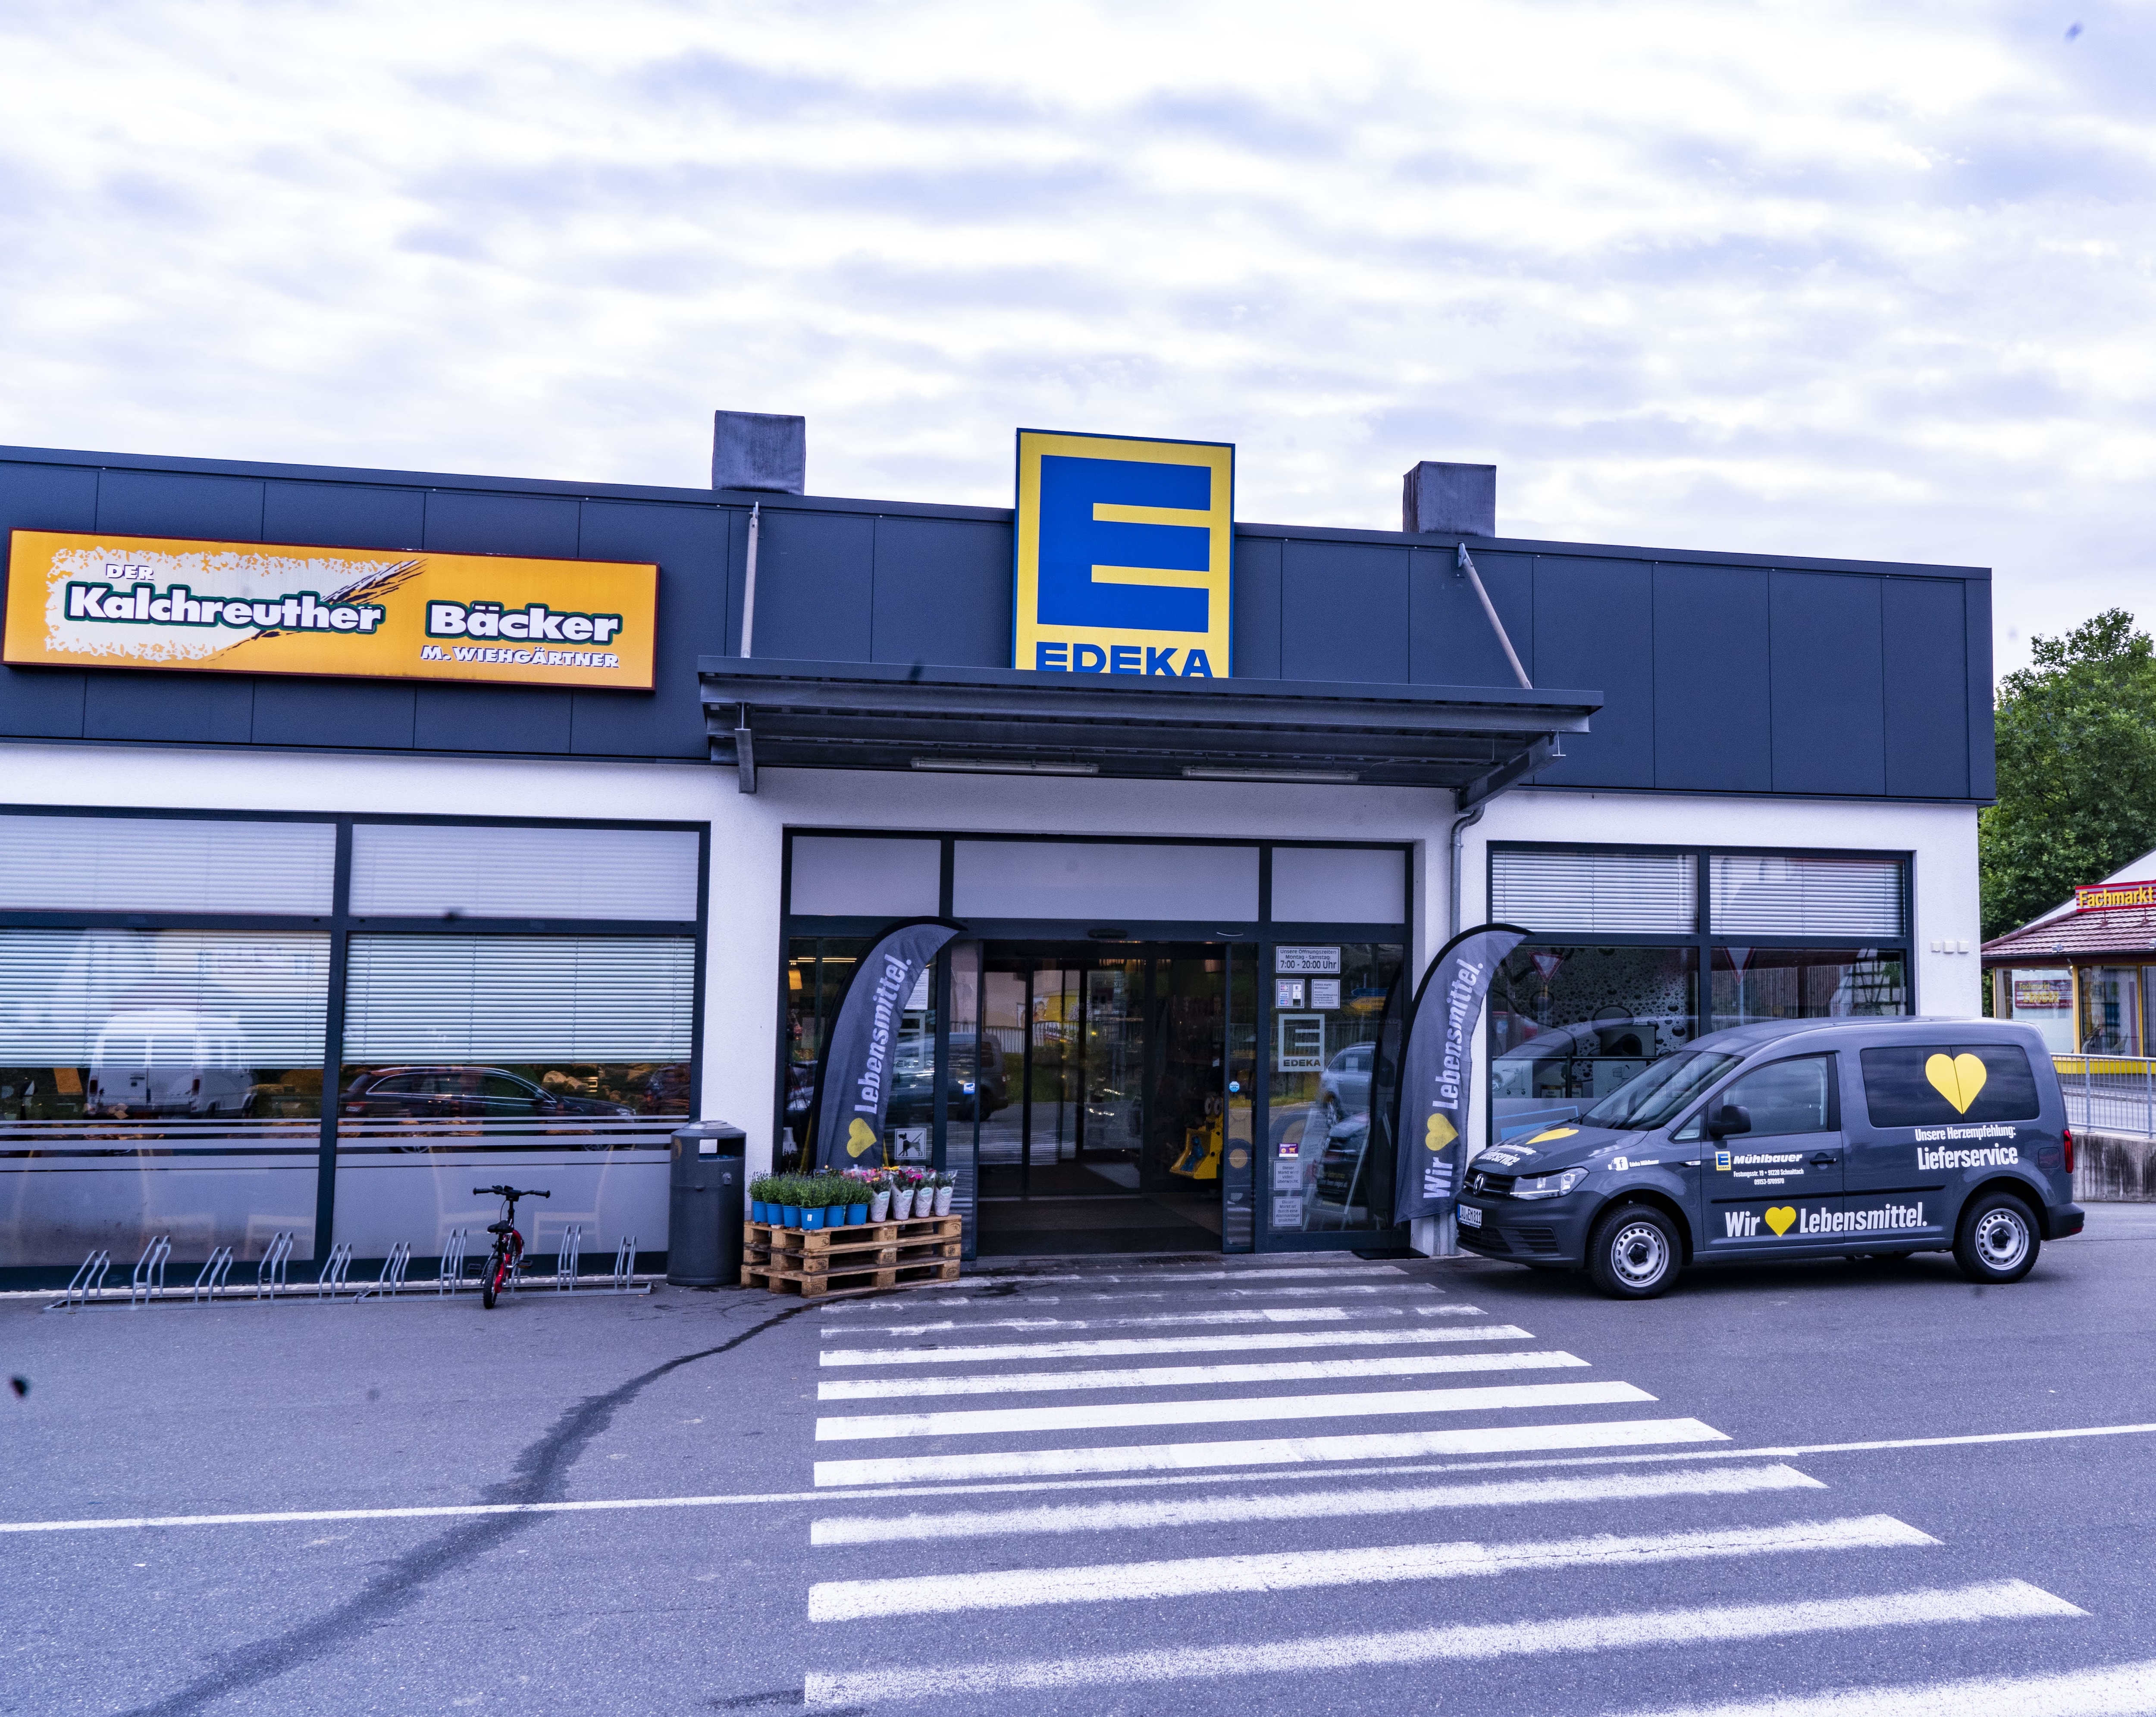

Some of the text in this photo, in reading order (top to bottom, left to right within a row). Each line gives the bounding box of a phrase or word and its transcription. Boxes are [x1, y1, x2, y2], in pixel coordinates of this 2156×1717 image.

[105, 563, 154, 581] DER
[68, 584, 383, 632] Kalchreuther
[428, 603, 621, 642] Bäcker
[421, 645, 619, 668] M. WIEHGÄRTNER
[1036, 641, 1213, 678] EDEKA
[2079, 886, 2154, 907] Fachmarkt
[1280, 960, 1295, 968] 7:00
[1302, 961, 1321, 969] 20:00
[1323, 961, 1337, 969] Uhr
[2023, 991, 2059, 1003] ZENGER
[854, 953, 912, 1115] Lebensmittel.
[1432, 958, 1484, 1110] Lebensmittel.
[1915, 1124, 2017, 1142] Unsere Herzempfehlung:
[1733, 1154, 1802, 1164] Mühlbauer
[1917, 1143, 2018, 1170] Lieferservice
[1423, 1156, 1453, 1199] Wir
[1724, 1202, 1928, 1237] Wir Lebensmittel.
